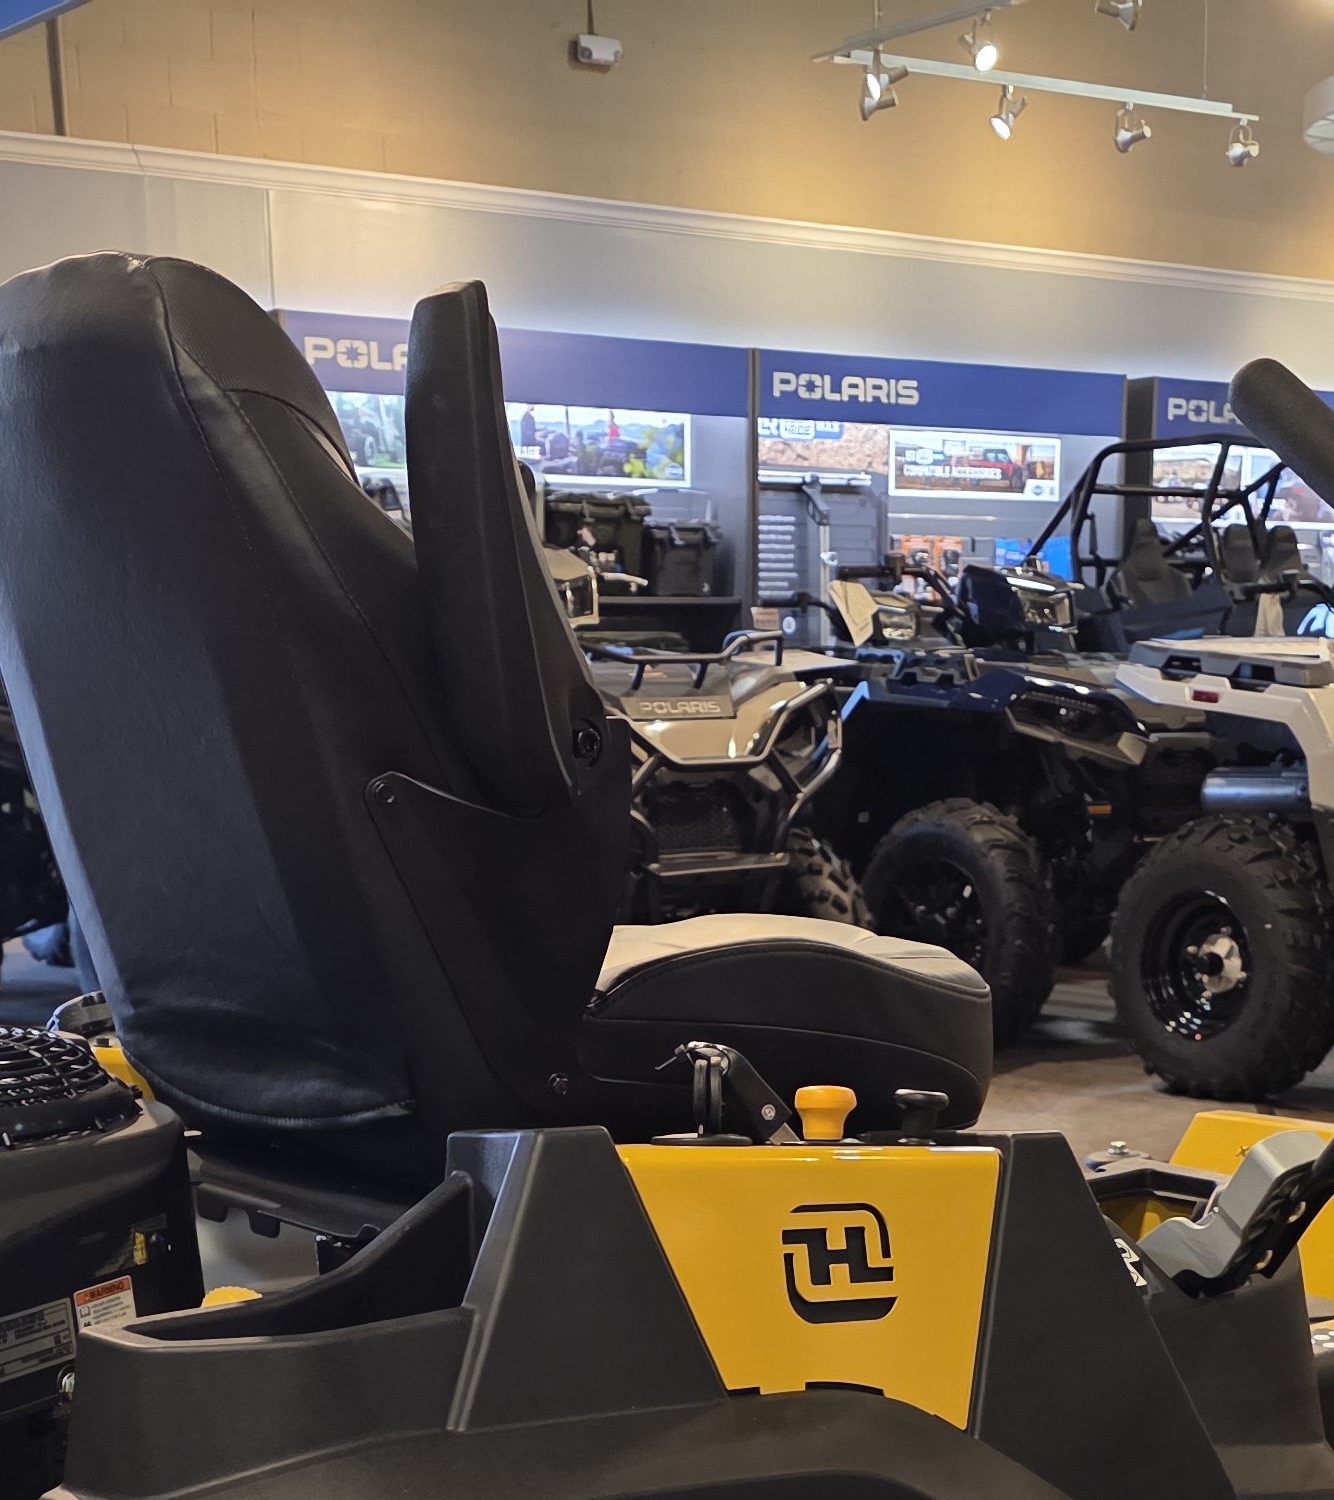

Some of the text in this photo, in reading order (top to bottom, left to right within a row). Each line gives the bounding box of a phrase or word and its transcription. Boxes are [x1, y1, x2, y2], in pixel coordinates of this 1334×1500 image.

[304, 336, 408, 371] POLA
[773, 371, 920, 405] POLARIS
[1168, 397, 1243, 426] POLA
[638, 701, 721, 714] POLARIS
[90, 1281, 125, 1298] WARNING
